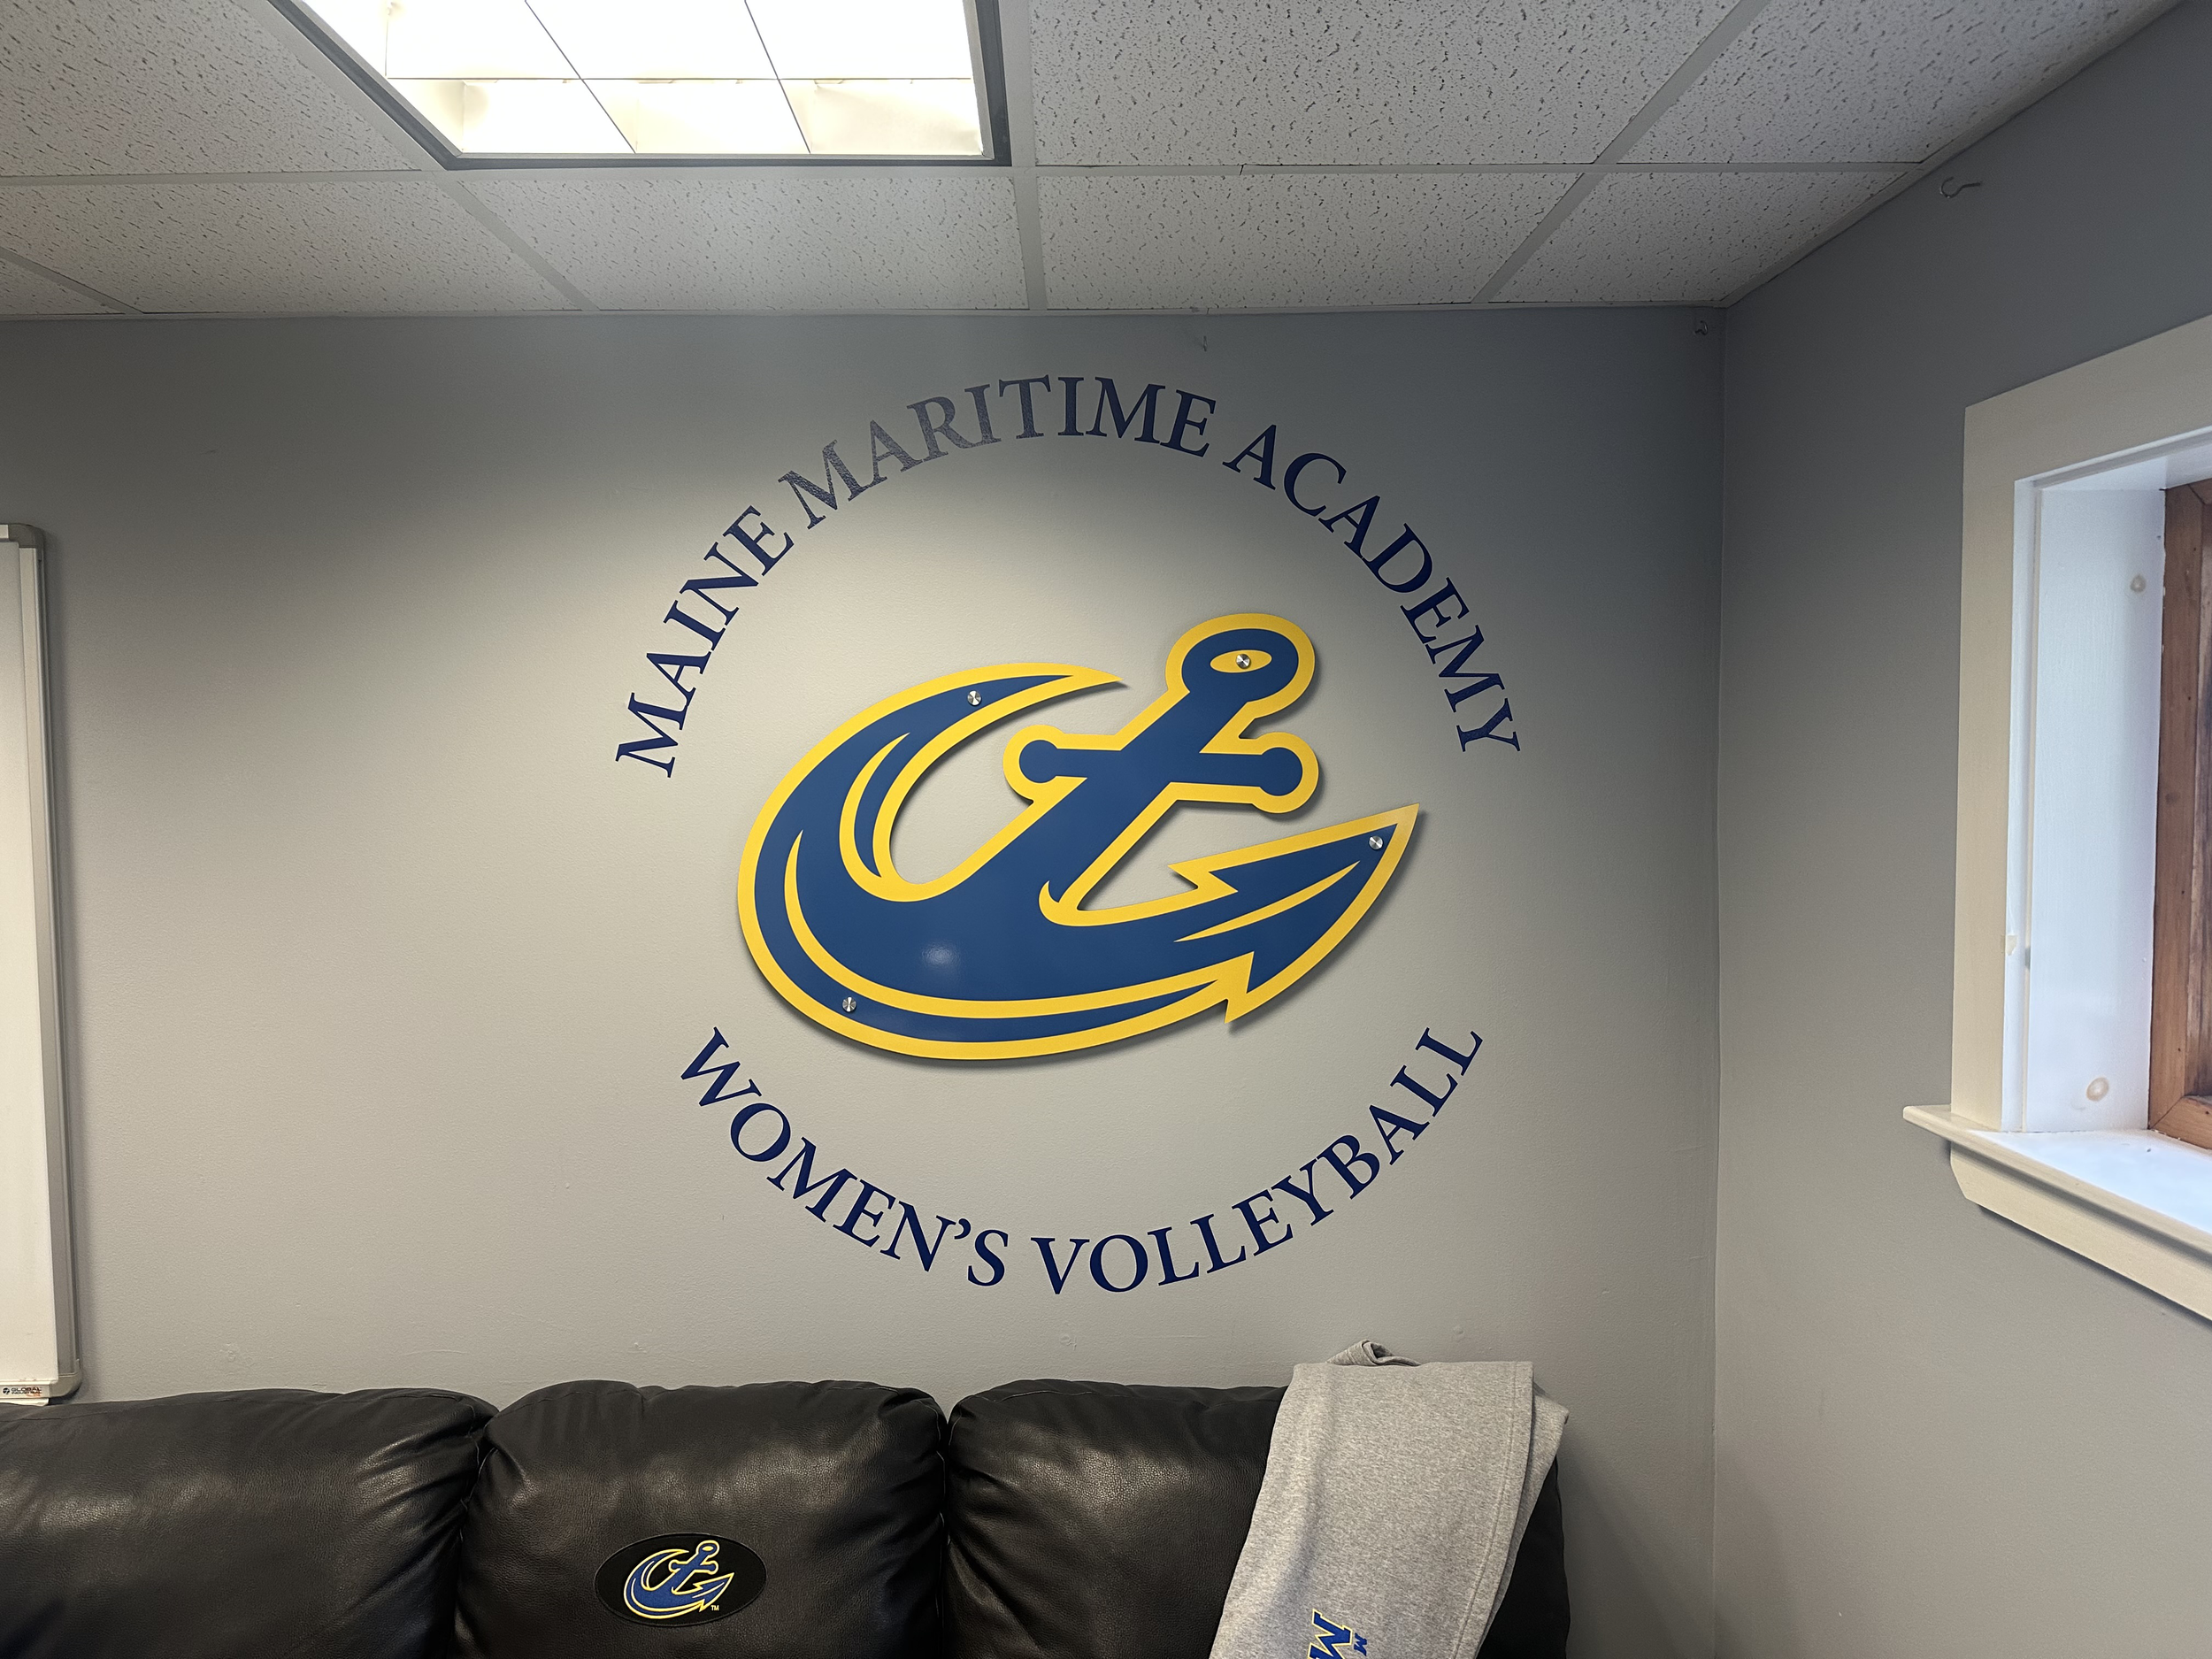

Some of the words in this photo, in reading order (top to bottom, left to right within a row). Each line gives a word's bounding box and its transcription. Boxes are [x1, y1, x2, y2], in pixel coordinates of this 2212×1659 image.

[616, 505, 795, 777] MAINE
[778, 374, 1217, 530] MARITIME
[1222, 424, 1521, 752] ACADEMY
[680, 1026, 1009, 1287] WOMEN’S
[1030, 1026, 1484, 1295] VOLLEYBALL
